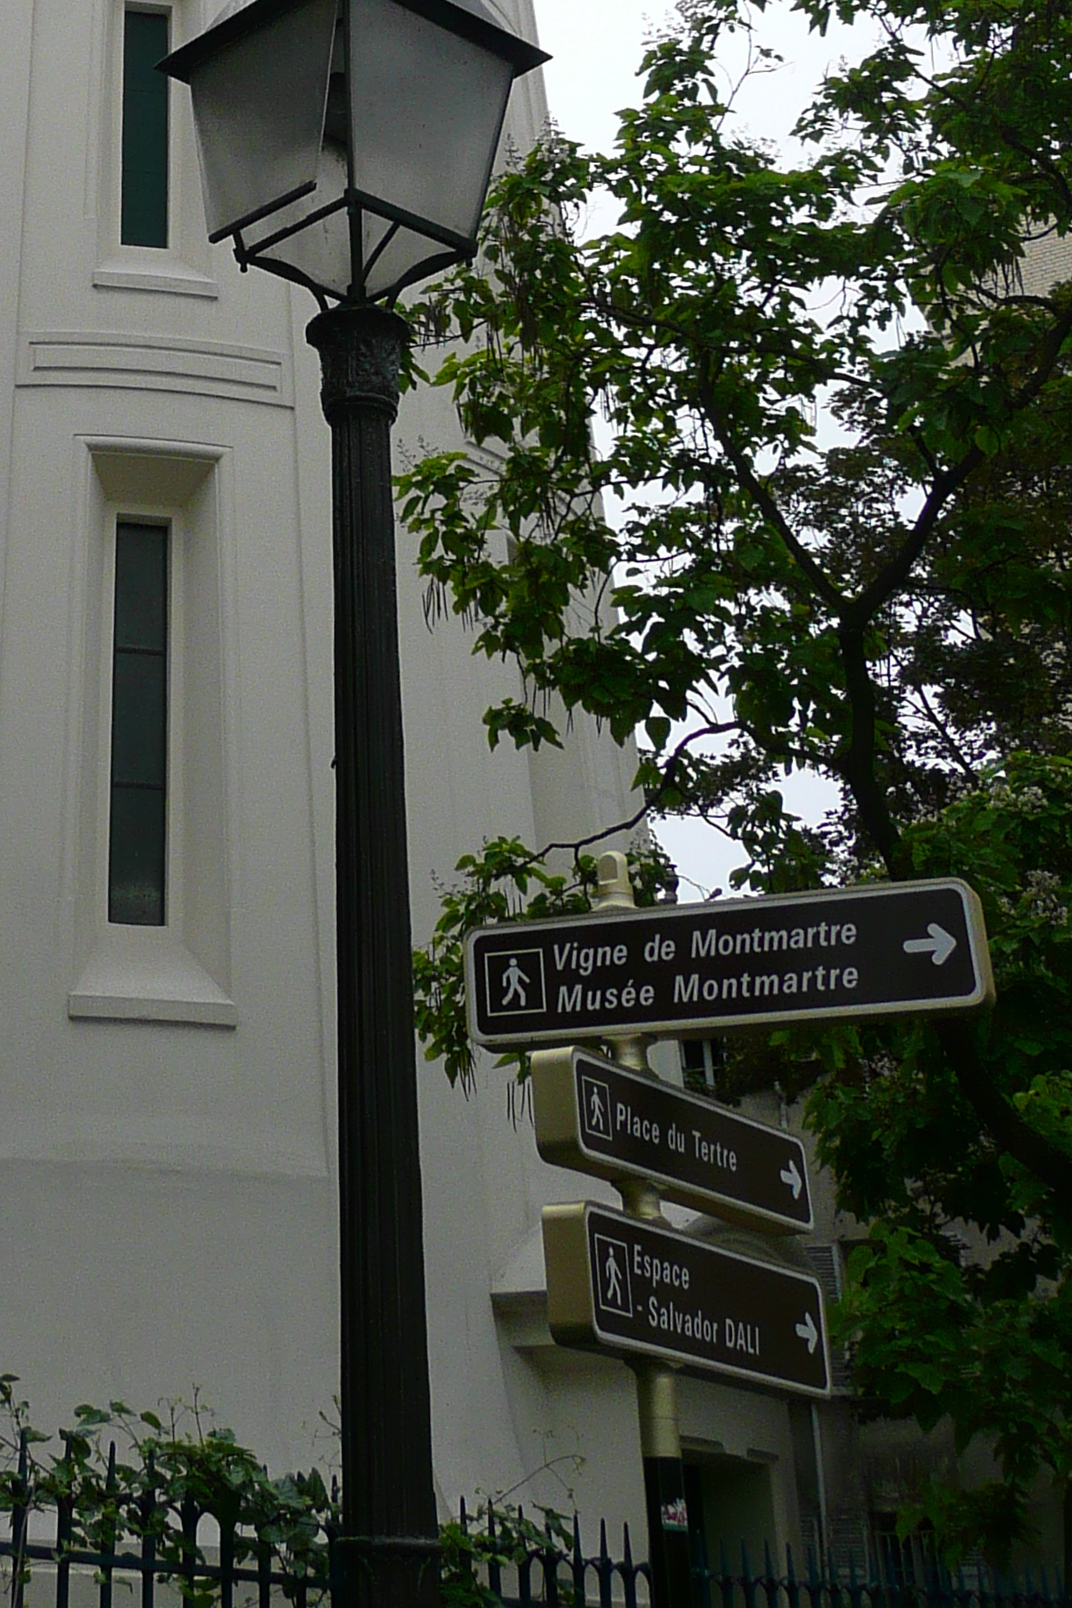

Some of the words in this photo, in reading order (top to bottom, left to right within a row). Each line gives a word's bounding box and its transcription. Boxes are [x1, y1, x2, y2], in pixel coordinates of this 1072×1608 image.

[553, 941, 628, 977] Vigne
[644, 934, 676, 964] de
[691, 922, 858, 959] Montmartre
[556, 979, 656, 1014] Musée
[673, 965, 859, 1004] Montmartre
[616, 1102, 660, 1144] Place
[667, 1123, 686, 1154] du
[691, 1130, 738, 1172] Tertre
[633, 1243, 690, 1290] Espace
[647, 1295, 719, 1343] Salvador
[724, 1318, 760, 1356] DALI
